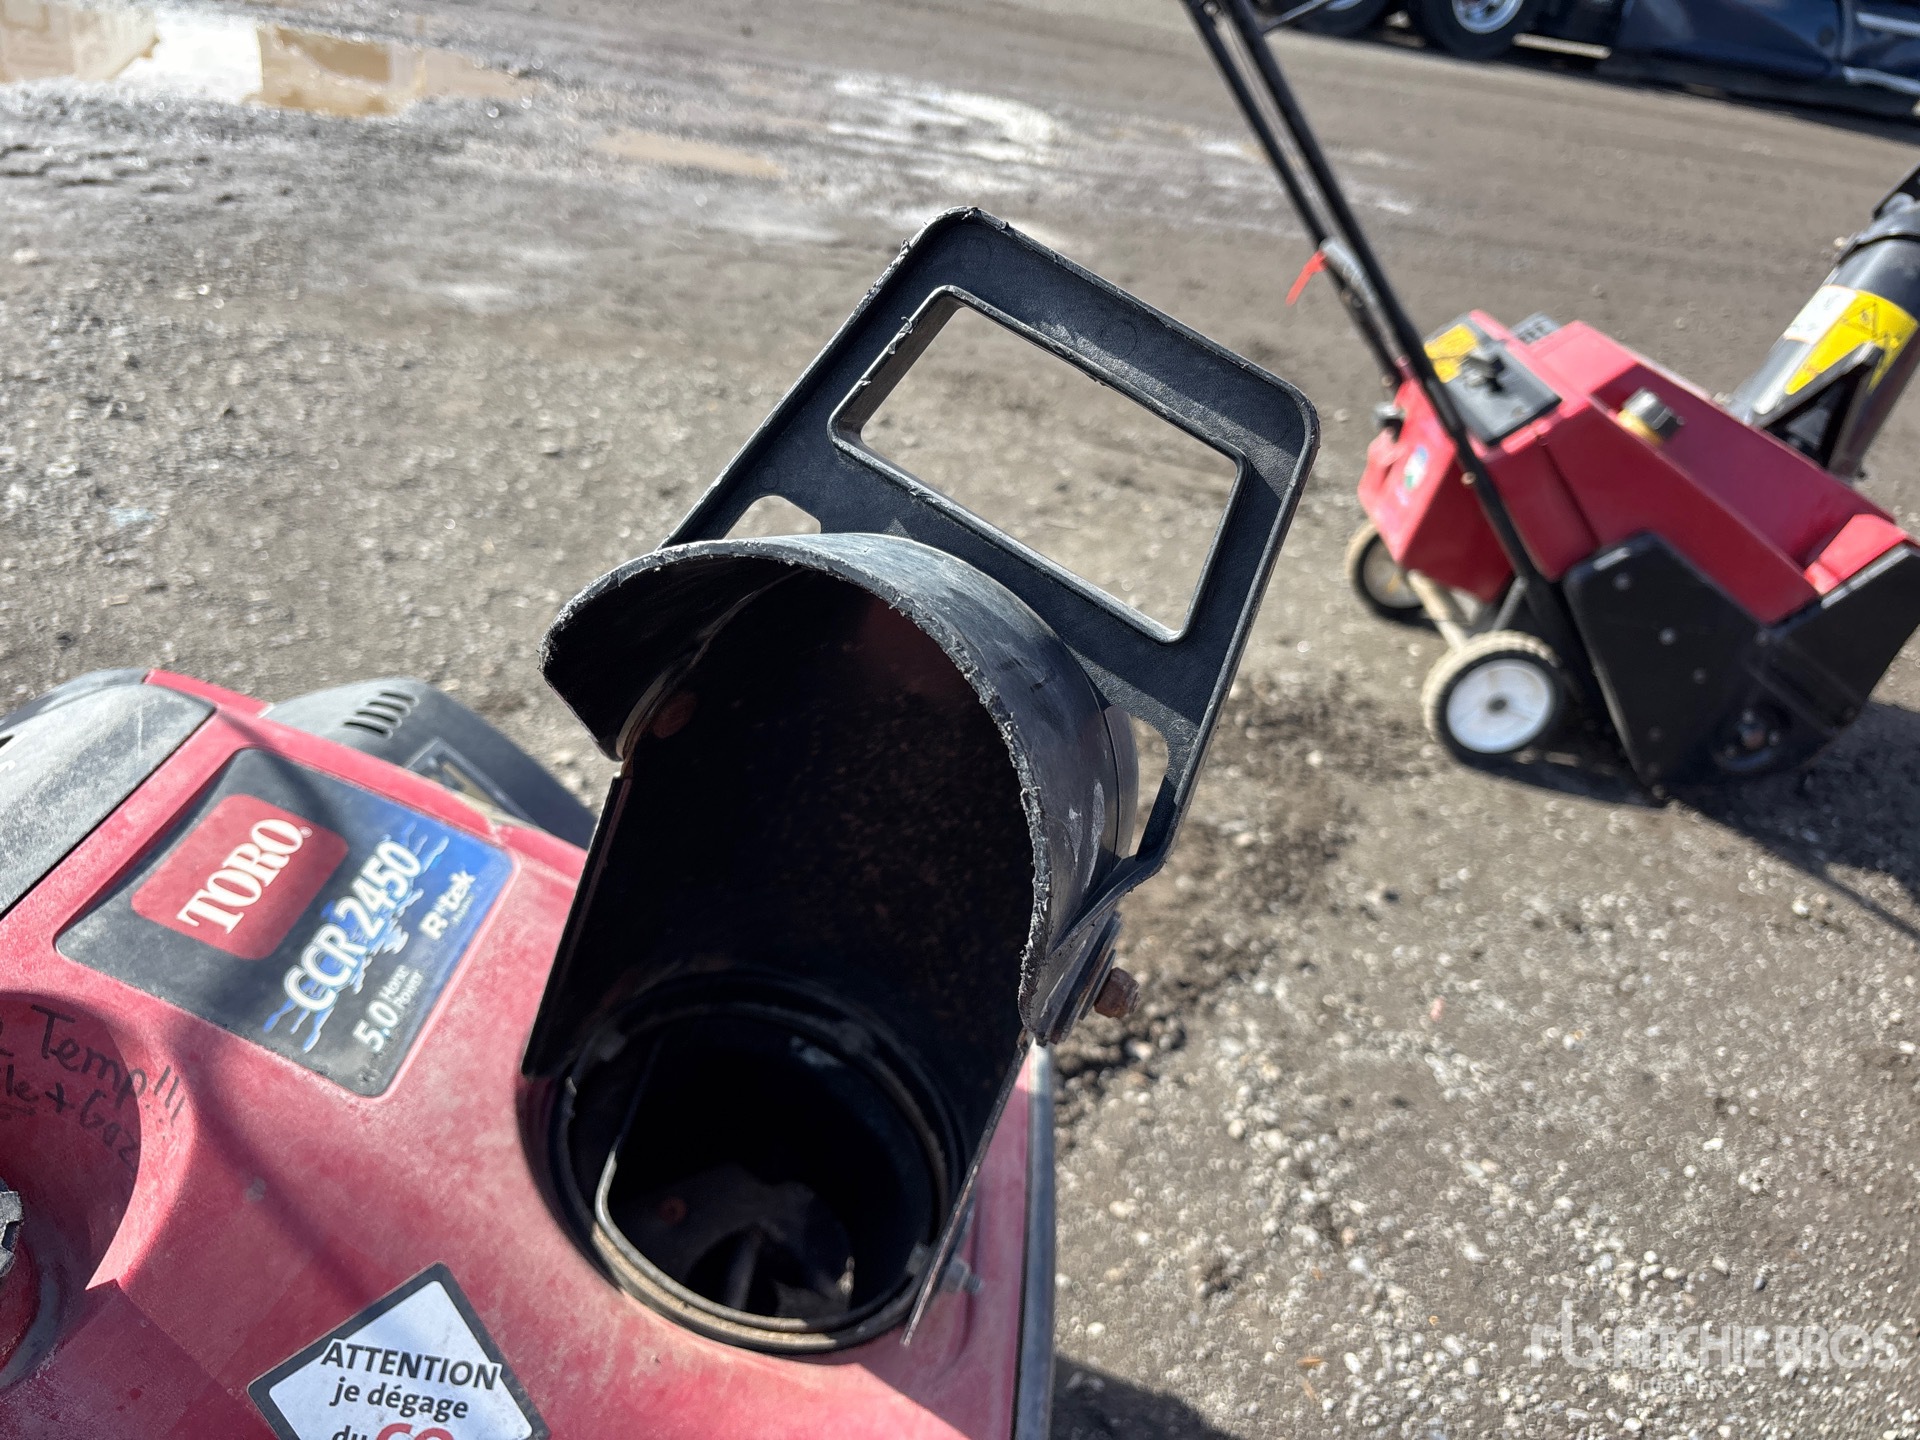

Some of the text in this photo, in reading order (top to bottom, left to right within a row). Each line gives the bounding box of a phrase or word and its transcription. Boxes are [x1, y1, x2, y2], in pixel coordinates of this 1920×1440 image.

[283, 840, 422, 1012] CCR 2450
[353, 999, 399, 1051] 5.0
[320, 1341, 498, 1390] ATTENTION
[329, 1376, 469, 1423] je dégage
